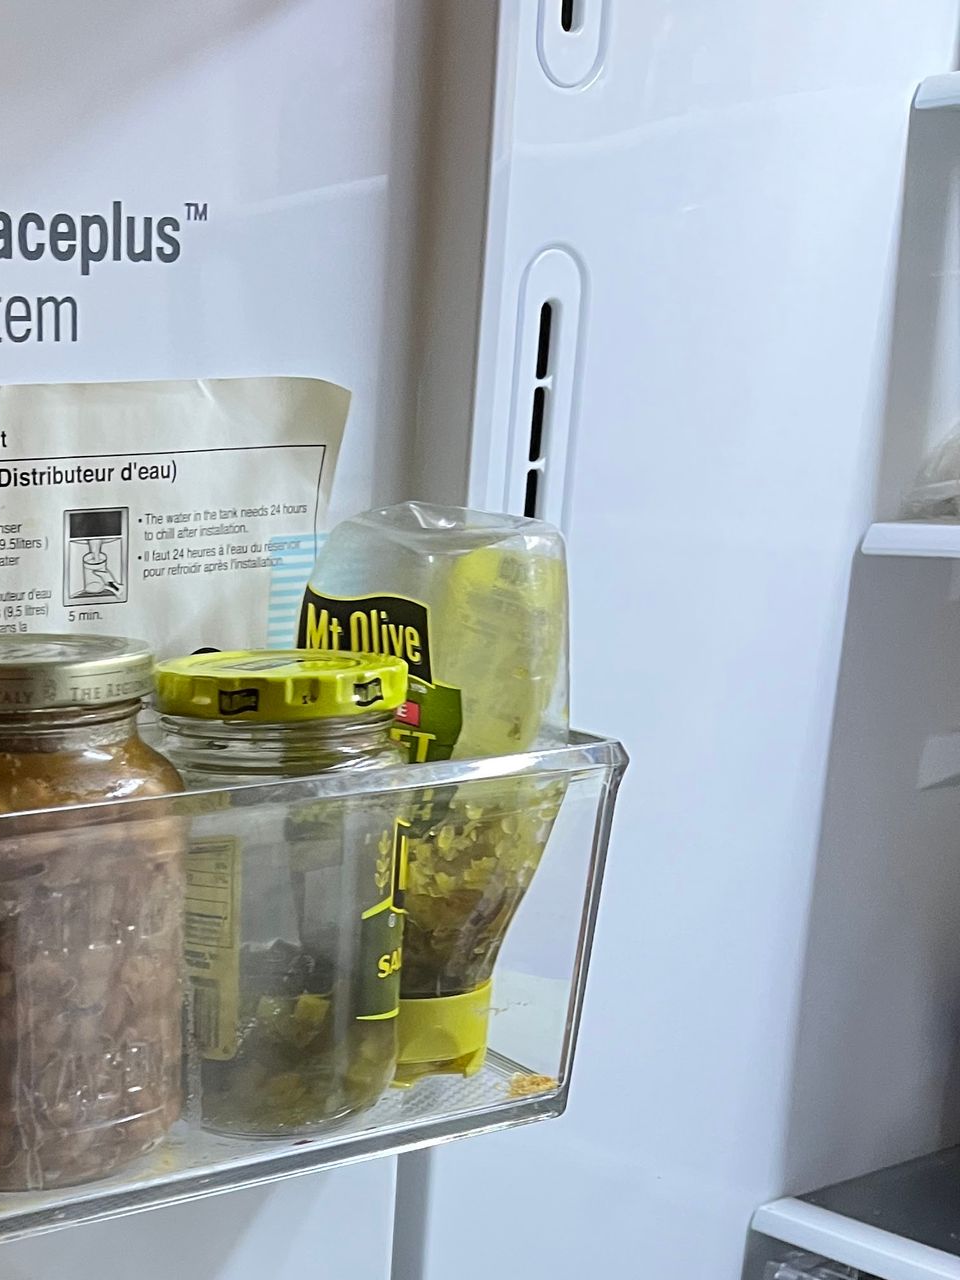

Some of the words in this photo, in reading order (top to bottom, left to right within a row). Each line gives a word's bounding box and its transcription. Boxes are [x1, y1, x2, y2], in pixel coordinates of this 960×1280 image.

[121, 460, 177, 483] d'eau)
[145, 511, 162, 525] The
[166, 510, 191, 523] water
[193, 509, 201, 520] in
[203, 508, 218, 521] the
[219, 506, 238, 519] tank
[240, 505, 269, 518] needs
[270, 503, 281, 515] 24
[283, 501, 307, 514] hours
[145, 529, 154, 541] to
[156, 527, 174, 539] chill
[177, 524, 197, 538] after
[200, 521, 249, 536] installation.
[151, 549, 170, 562] faut
[172, 547, 184, 560] 24
[186, 545, 216, 560] heures
[227, 543, 248, 556] l'eau
[250, 541, 262, 554] du
[143, 566, 164, 580] pour
[167, 561, 201, 576] refroidir
[203, 559, 228, 574] après
[68, 612, 75, 622] 5
[78, 610, 103, 621] min.
